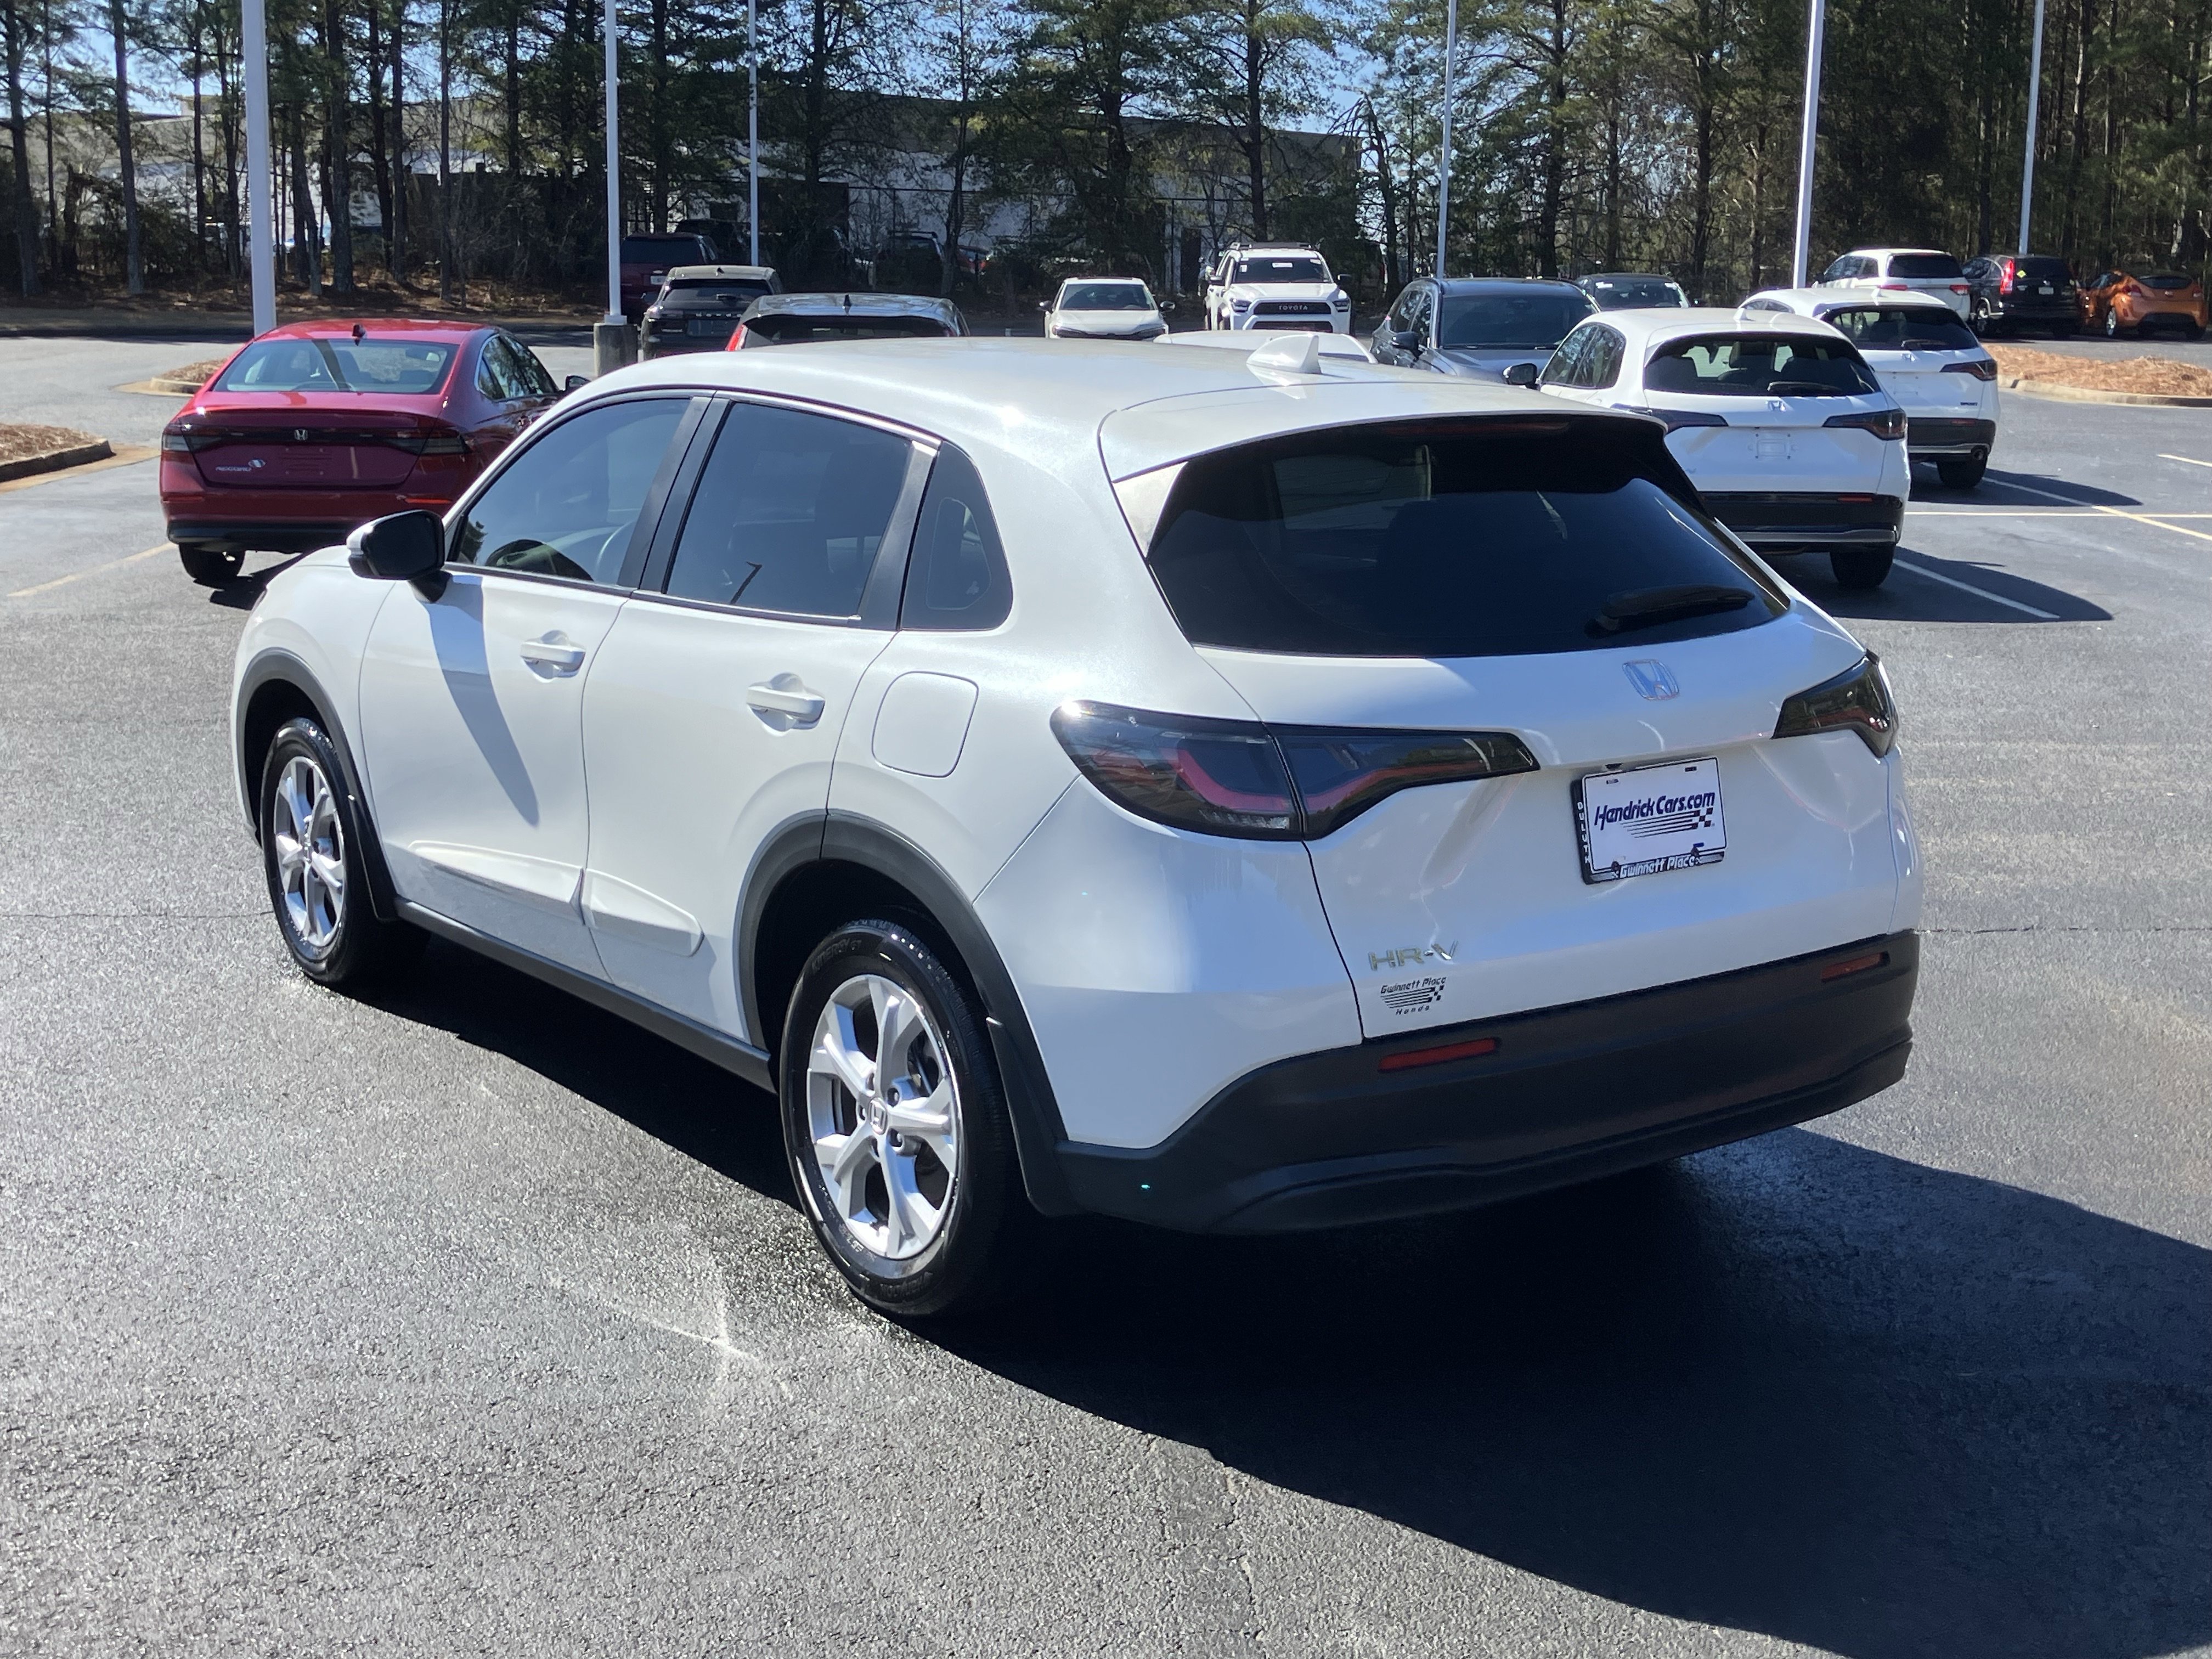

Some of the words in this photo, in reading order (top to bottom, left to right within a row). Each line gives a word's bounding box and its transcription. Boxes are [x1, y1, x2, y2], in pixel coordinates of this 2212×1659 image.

[1667, 854, 1695, 871] Place
[1368, 940, 1459, 971] HR-V
[1396, 1005, 1430, 1015] Honda
